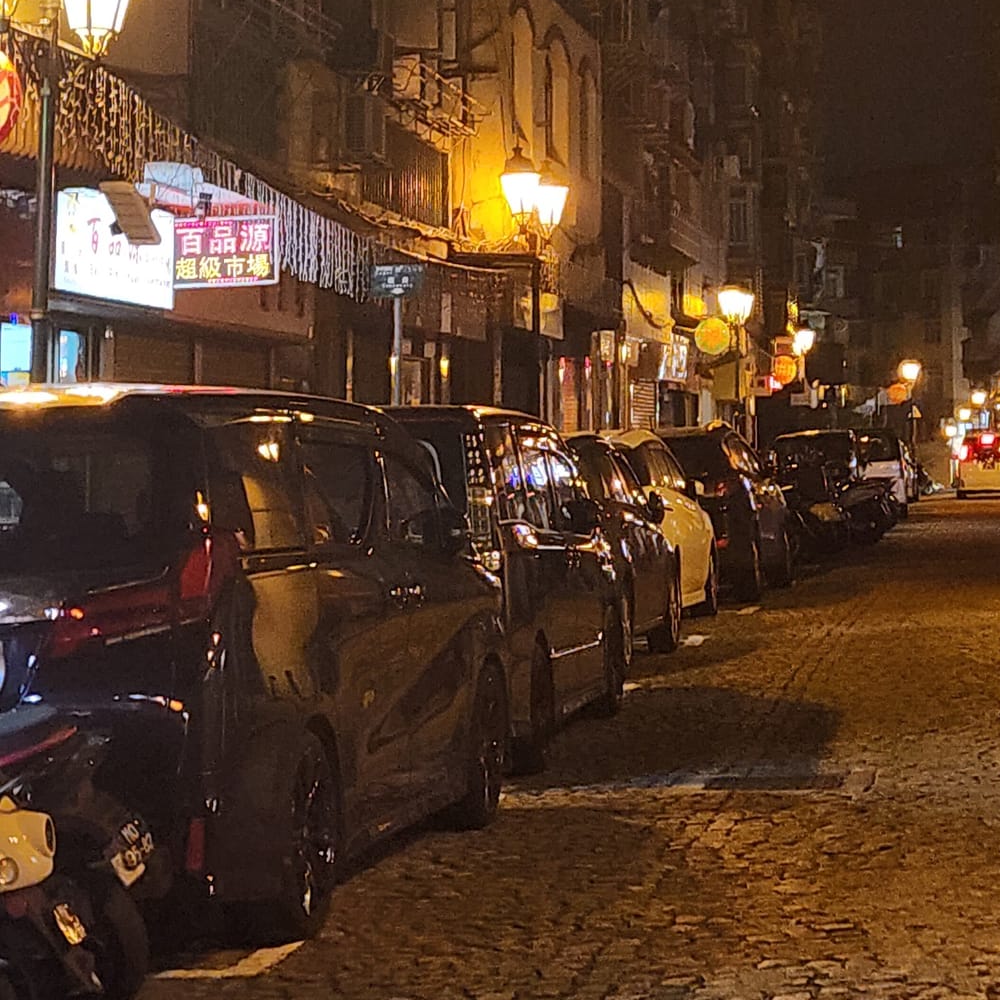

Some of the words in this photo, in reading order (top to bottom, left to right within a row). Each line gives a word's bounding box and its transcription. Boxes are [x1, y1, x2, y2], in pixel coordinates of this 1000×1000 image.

[175, 224, 271, 255] 百品源
[175, 254, 271, 280] 超級市場
